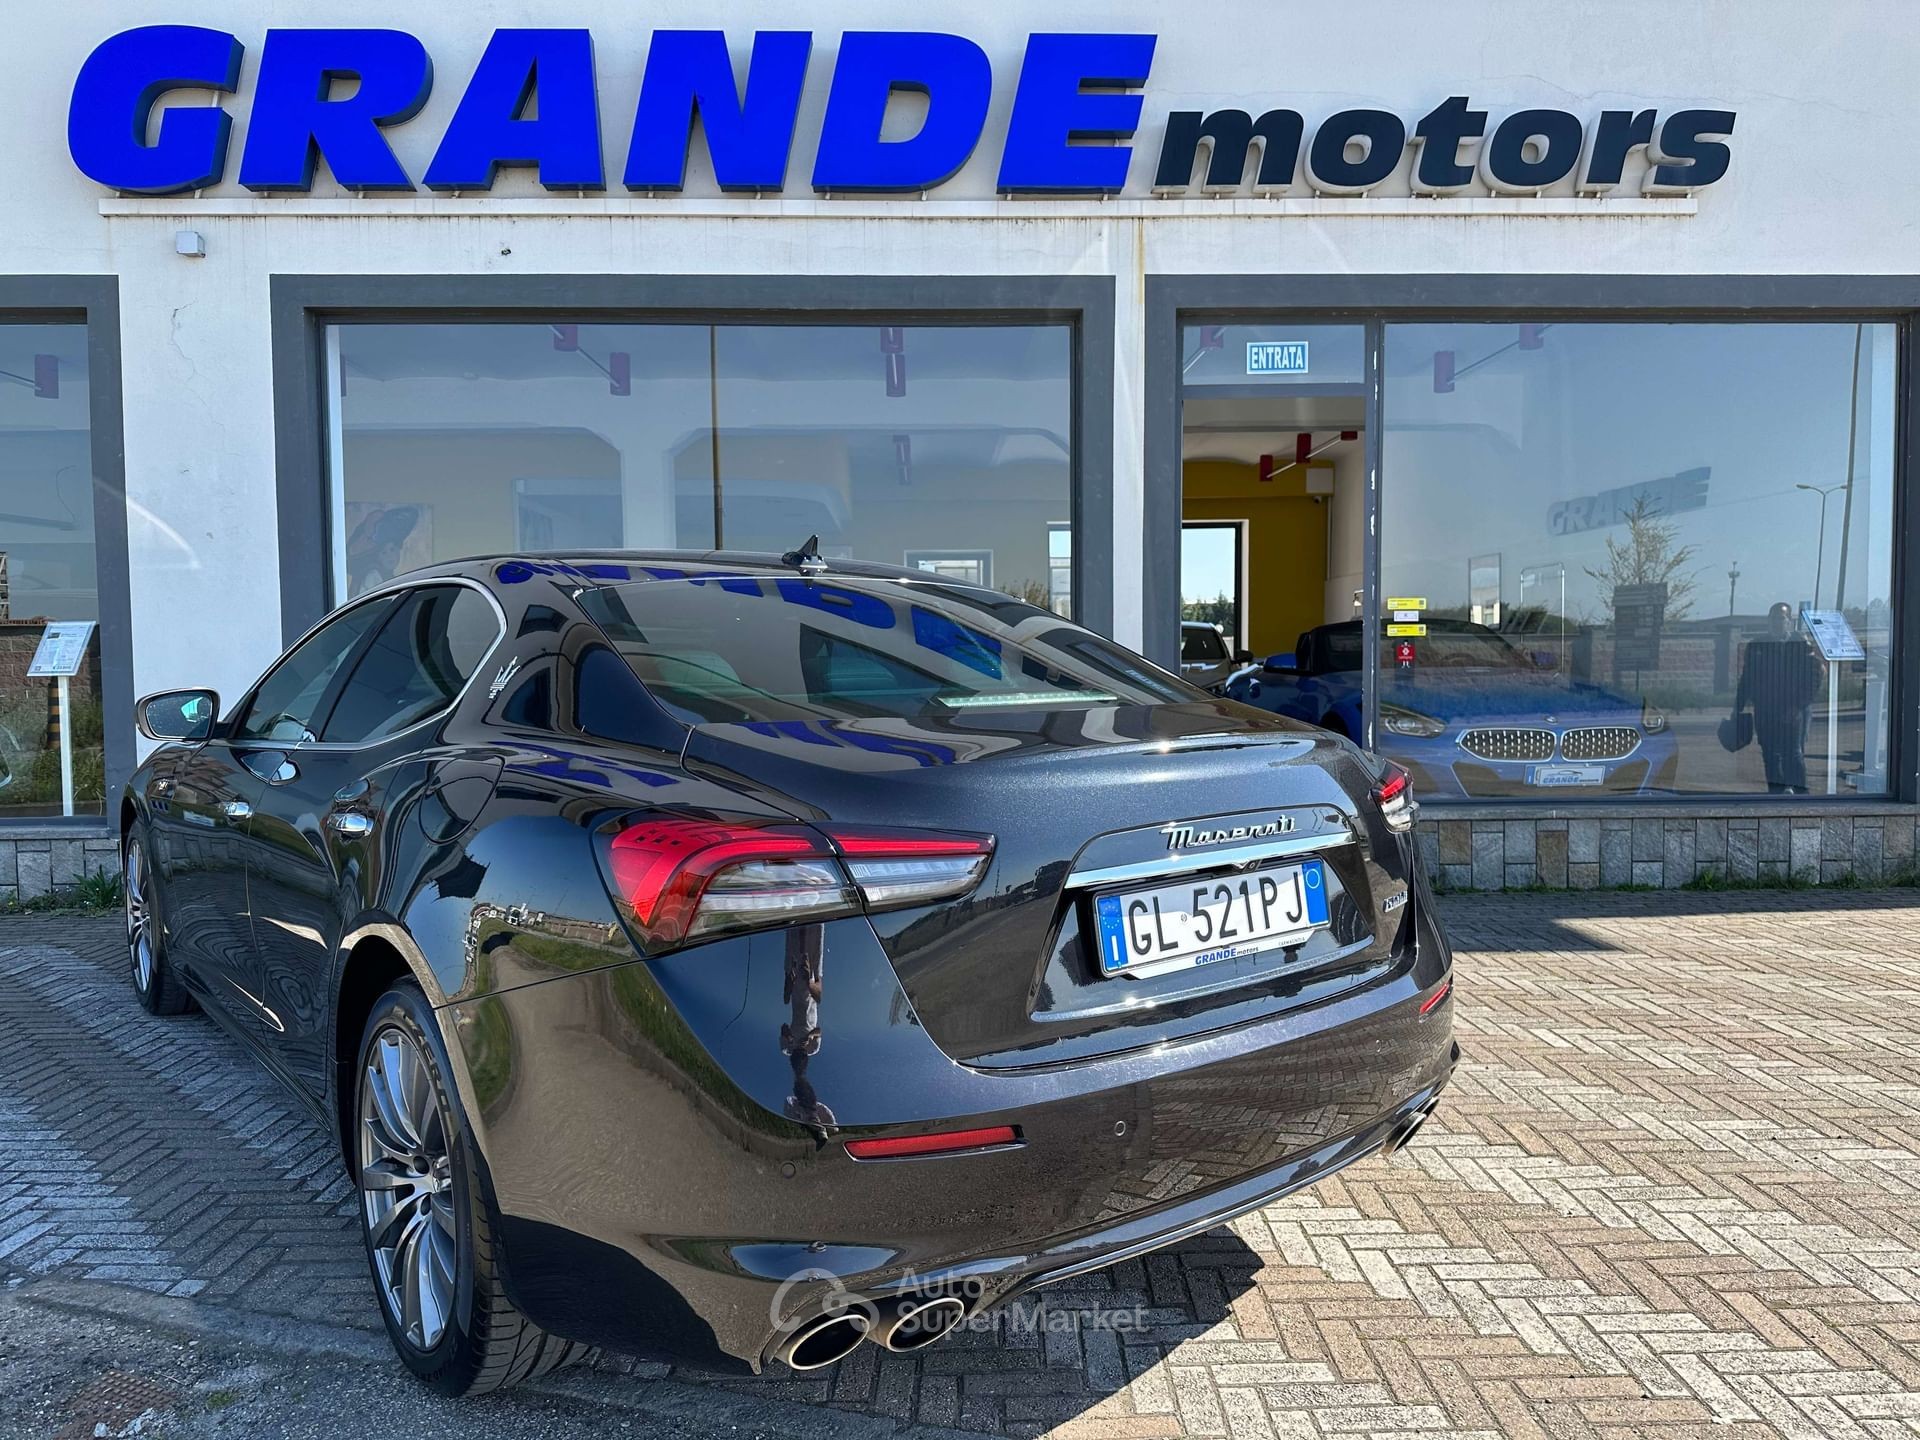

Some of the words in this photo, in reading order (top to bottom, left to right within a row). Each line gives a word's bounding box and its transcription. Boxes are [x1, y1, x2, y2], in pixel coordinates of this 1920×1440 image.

[68, 25, 1156, 194] GRANDE
[1152, 96, 1737, 193] motors
[1251, 346, 1304, 369] ENTRATA
[1160, 814, 1303, 850] Maserati
[1128, 896, 1179, 956] GL
[1192, 871, 1303, 943] 521PJ
[1195, 948, 1237, 965] GRANDE
[1237, 946, 1259, 956] motors
